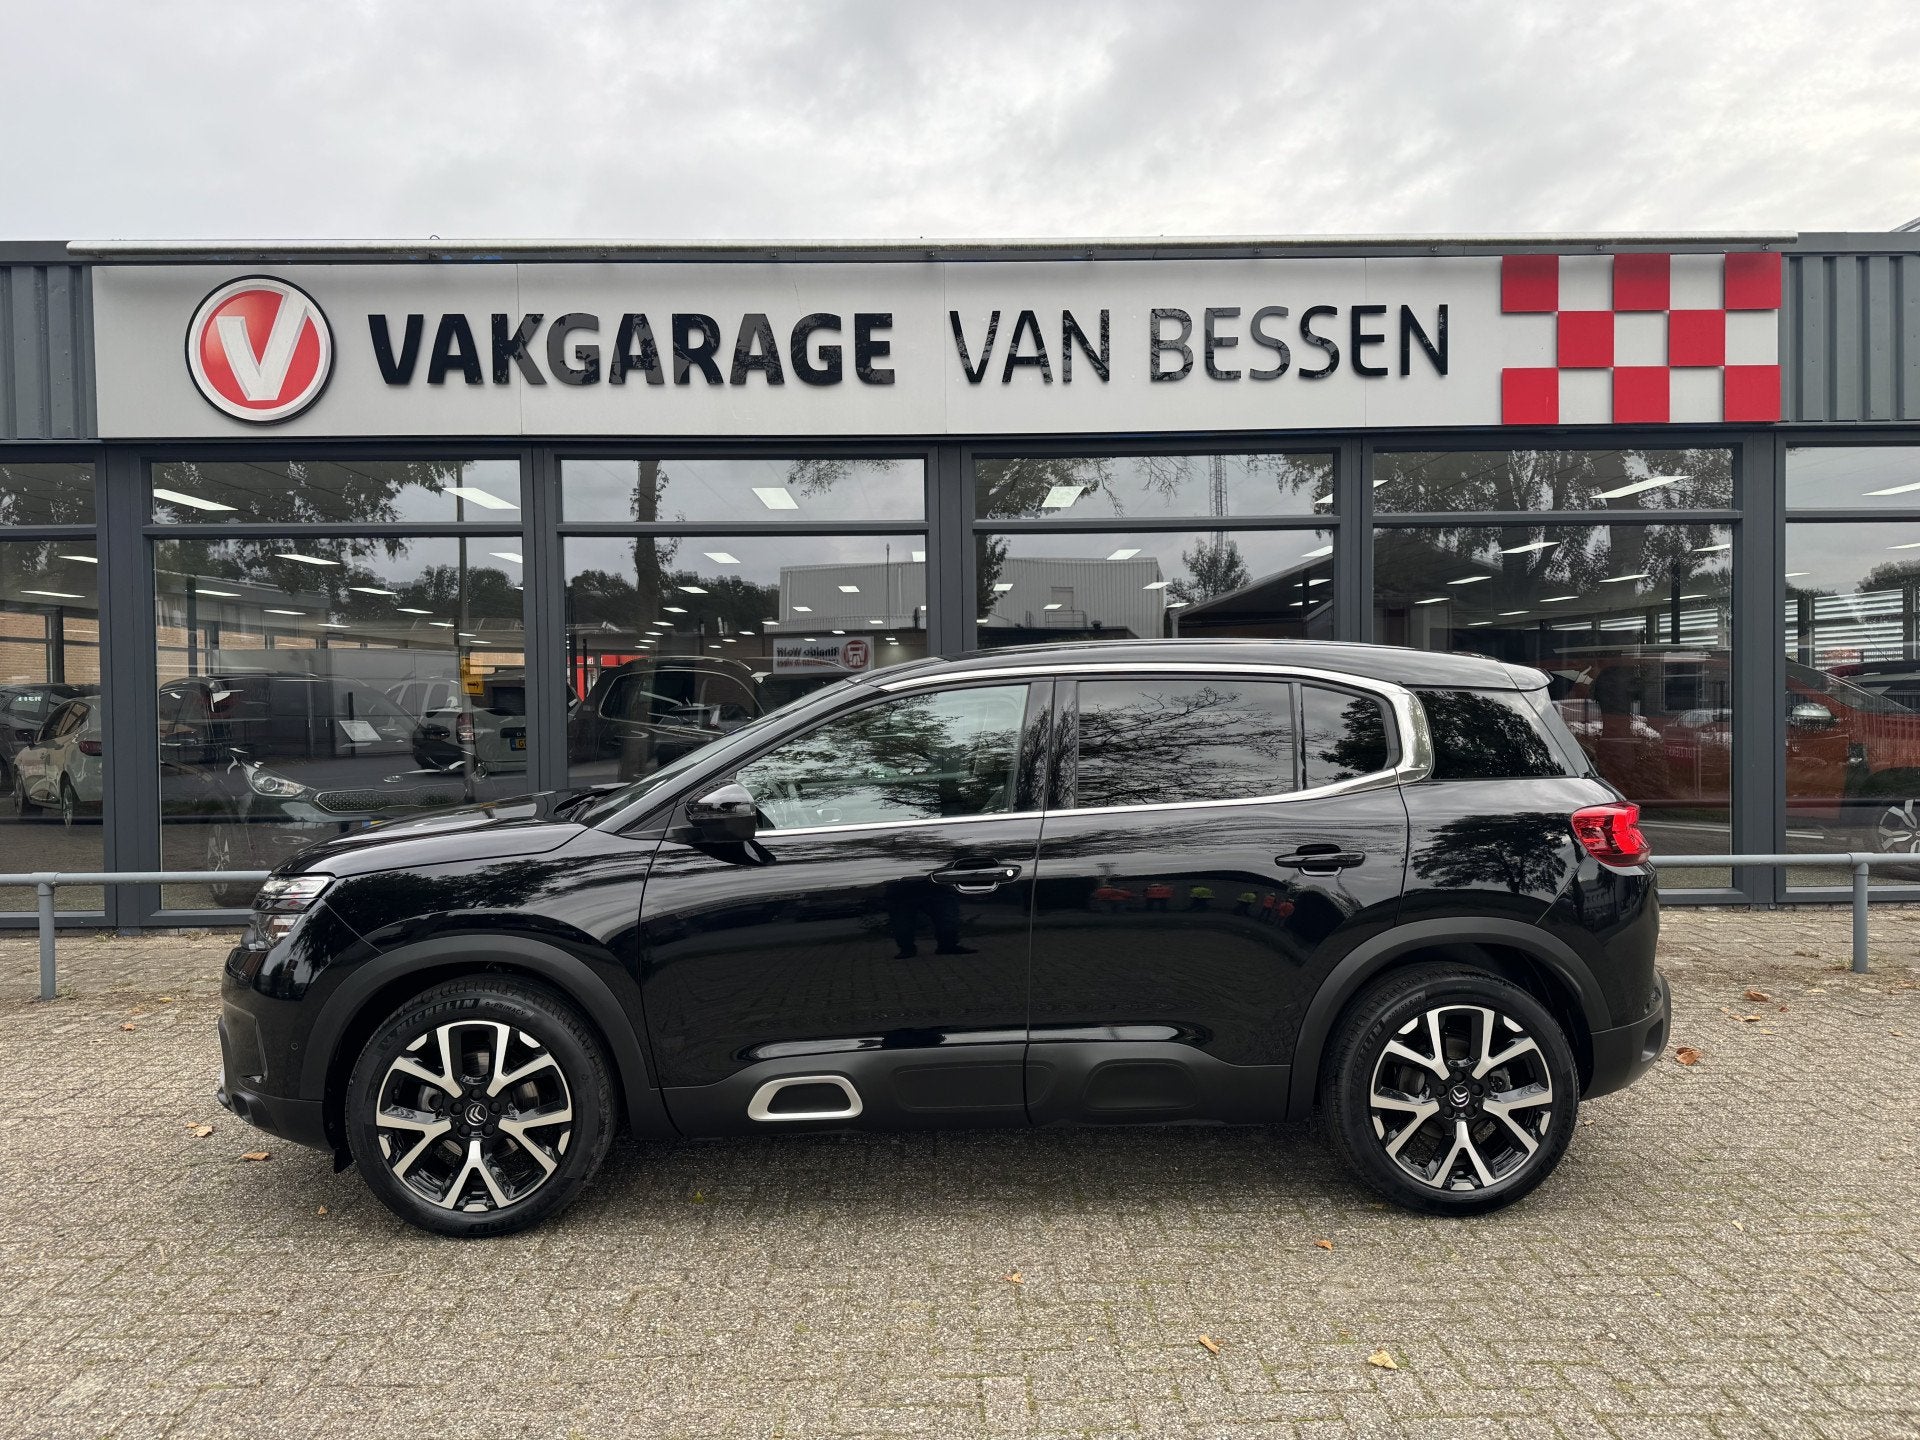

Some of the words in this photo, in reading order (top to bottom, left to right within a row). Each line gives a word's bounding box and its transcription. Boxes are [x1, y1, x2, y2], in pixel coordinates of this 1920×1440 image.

[215, 287, 308, 401] V
[368, 312, 896, 387] VAKGARAGE
[949, 308, 1110, 384] VAN
[1150, 304, 1449, 382] BESSEN
[395, 999, 476, 1036] MICHELIN
